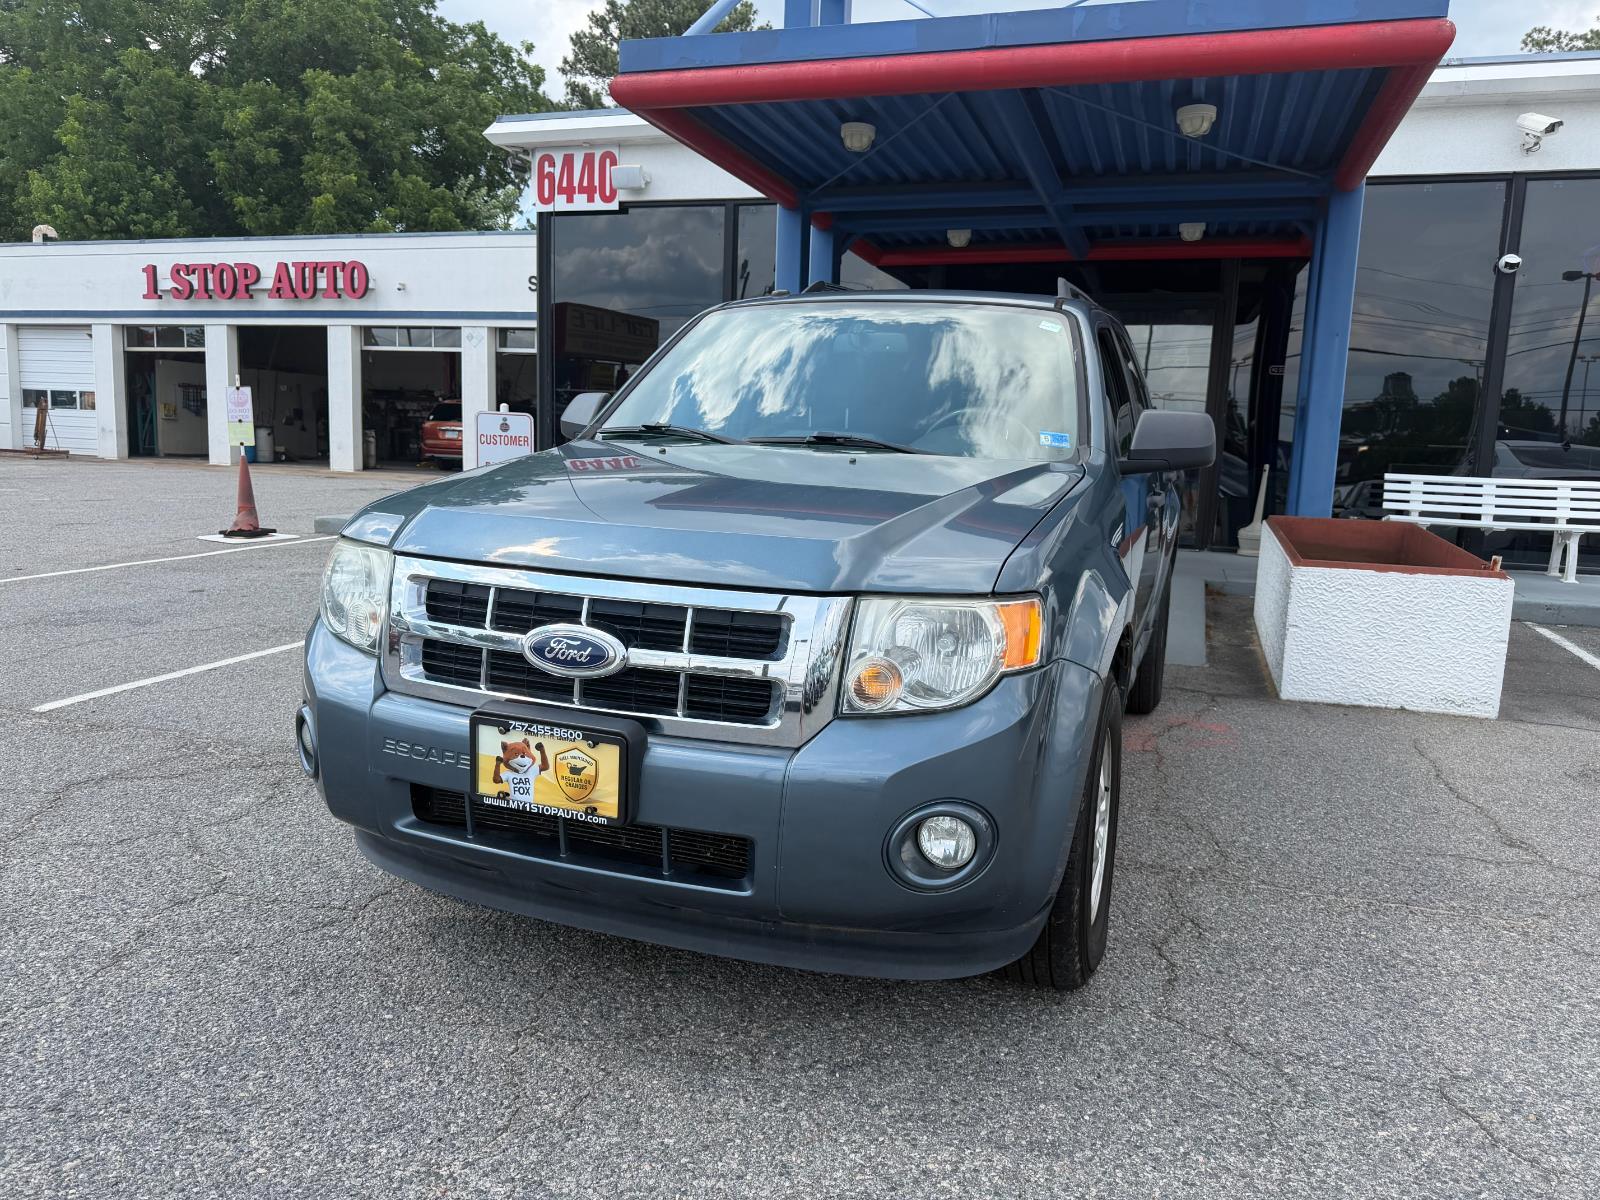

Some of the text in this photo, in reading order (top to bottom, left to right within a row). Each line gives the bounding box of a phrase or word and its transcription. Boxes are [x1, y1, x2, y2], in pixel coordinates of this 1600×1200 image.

[536, 150, 617, 206] 6440
[141, 260, 370, 300] 1 STOP AUTO
[479, 433, 529, 447] CUSTOMER
[544, 637, 590, 663] Ford
[508, 720, 583, 740] 757-455-8600
[382, 736, 471, 769] ESCAPE
[511, 776, 531, 786] CAR
[513, 786, 531, 796] FOX
[483, 796, 608, 825] www.MY1STOPAUTO.com
